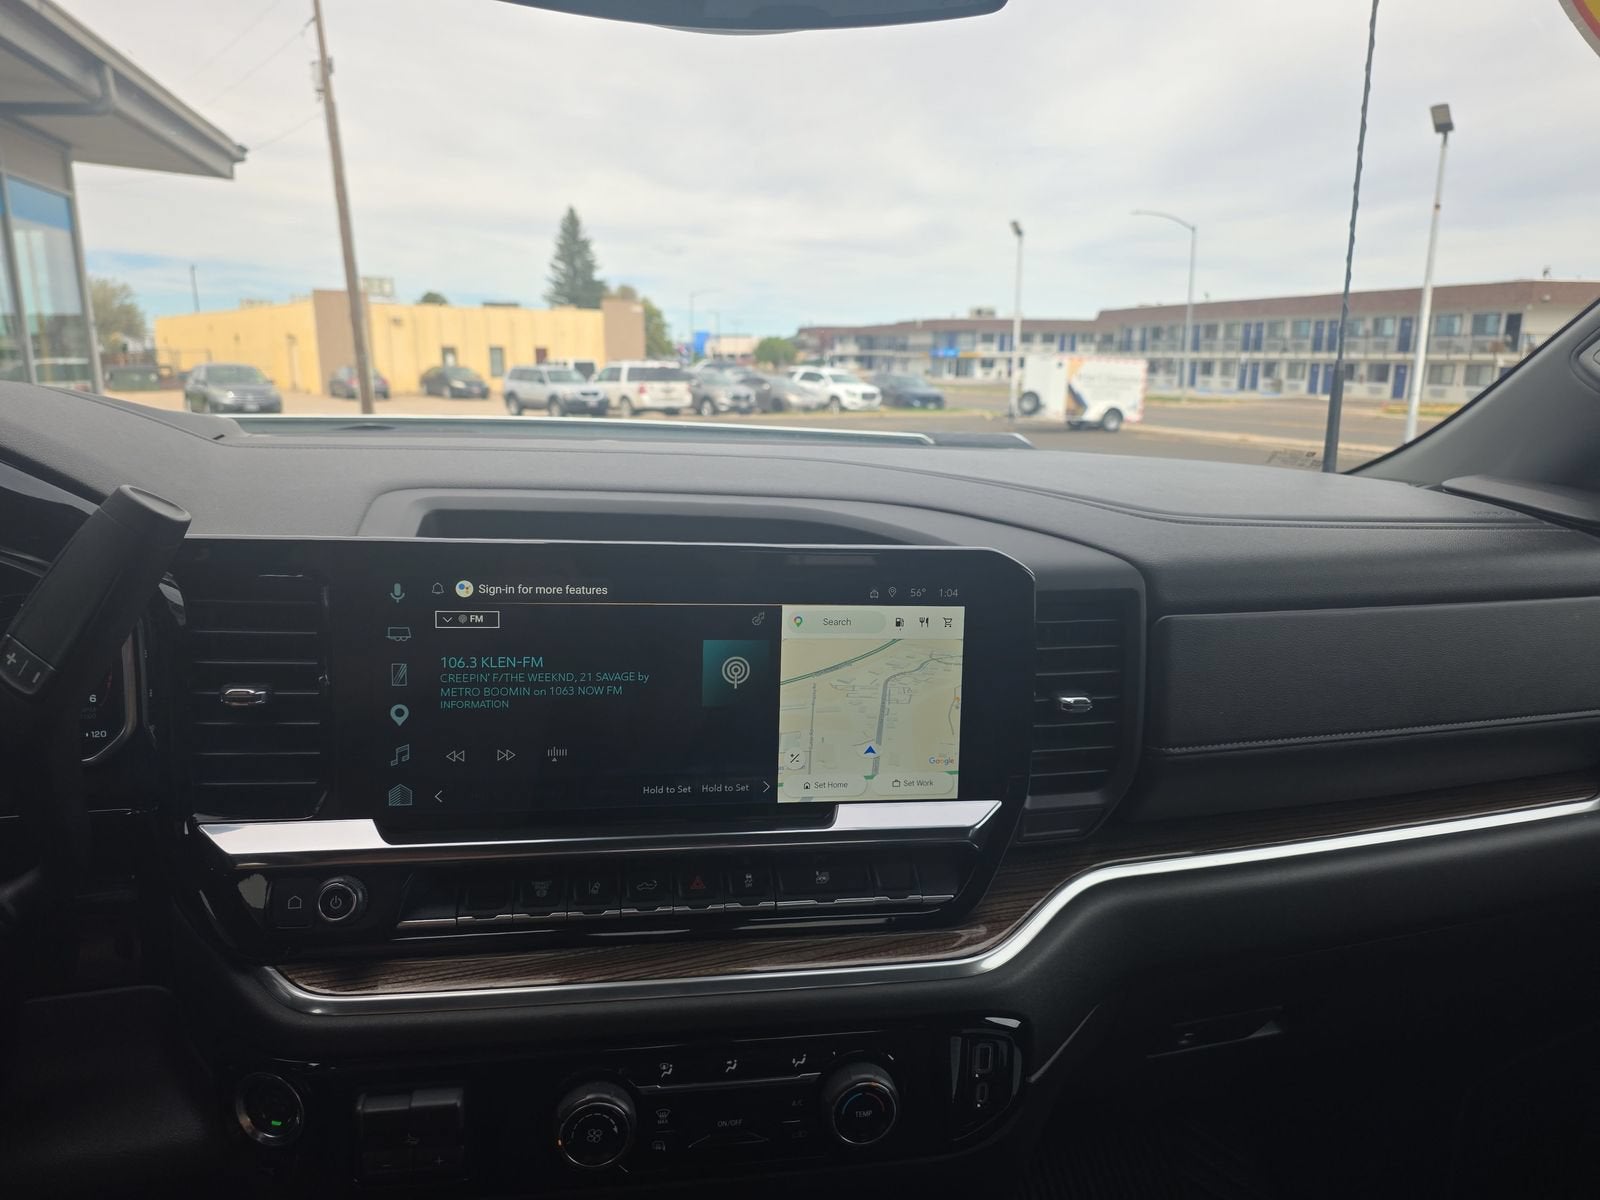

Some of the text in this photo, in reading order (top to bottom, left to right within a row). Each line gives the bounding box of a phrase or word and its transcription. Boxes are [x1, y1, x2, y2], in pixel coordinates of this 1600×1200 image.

[478, 584, 608, 596] Sign-in for more features
[939, 588, 959, 597] 1:04
[470, 615, 484, 623] FM
[822, 617, 852, 626] Search
[440, 656, 544, 669] 106.3 KLEN-FM
[440, 671, 650, 683] CREEPIN' F/THE WEEKND, 21 SAVAGE by
[440, 686, 623, 697] METRO BOOMIN on 1063 NOW FM
[89, 694, 97, 703] 6
[440, 699, 509, 709] INFORMATION
[91, 730, 107, 738] 120
[928, 756, 955, 766] Google
[814, 781, 849, 789] Set Home
[903, 779, 934, 787] Set Work
[643, 785, 691, 794] Hold to Set
[701, 783, 750, 793] Hold to Set
[855, 1110, 873, 1118] TEMP
[717, 1118, 744, 1128] ON/OFF
